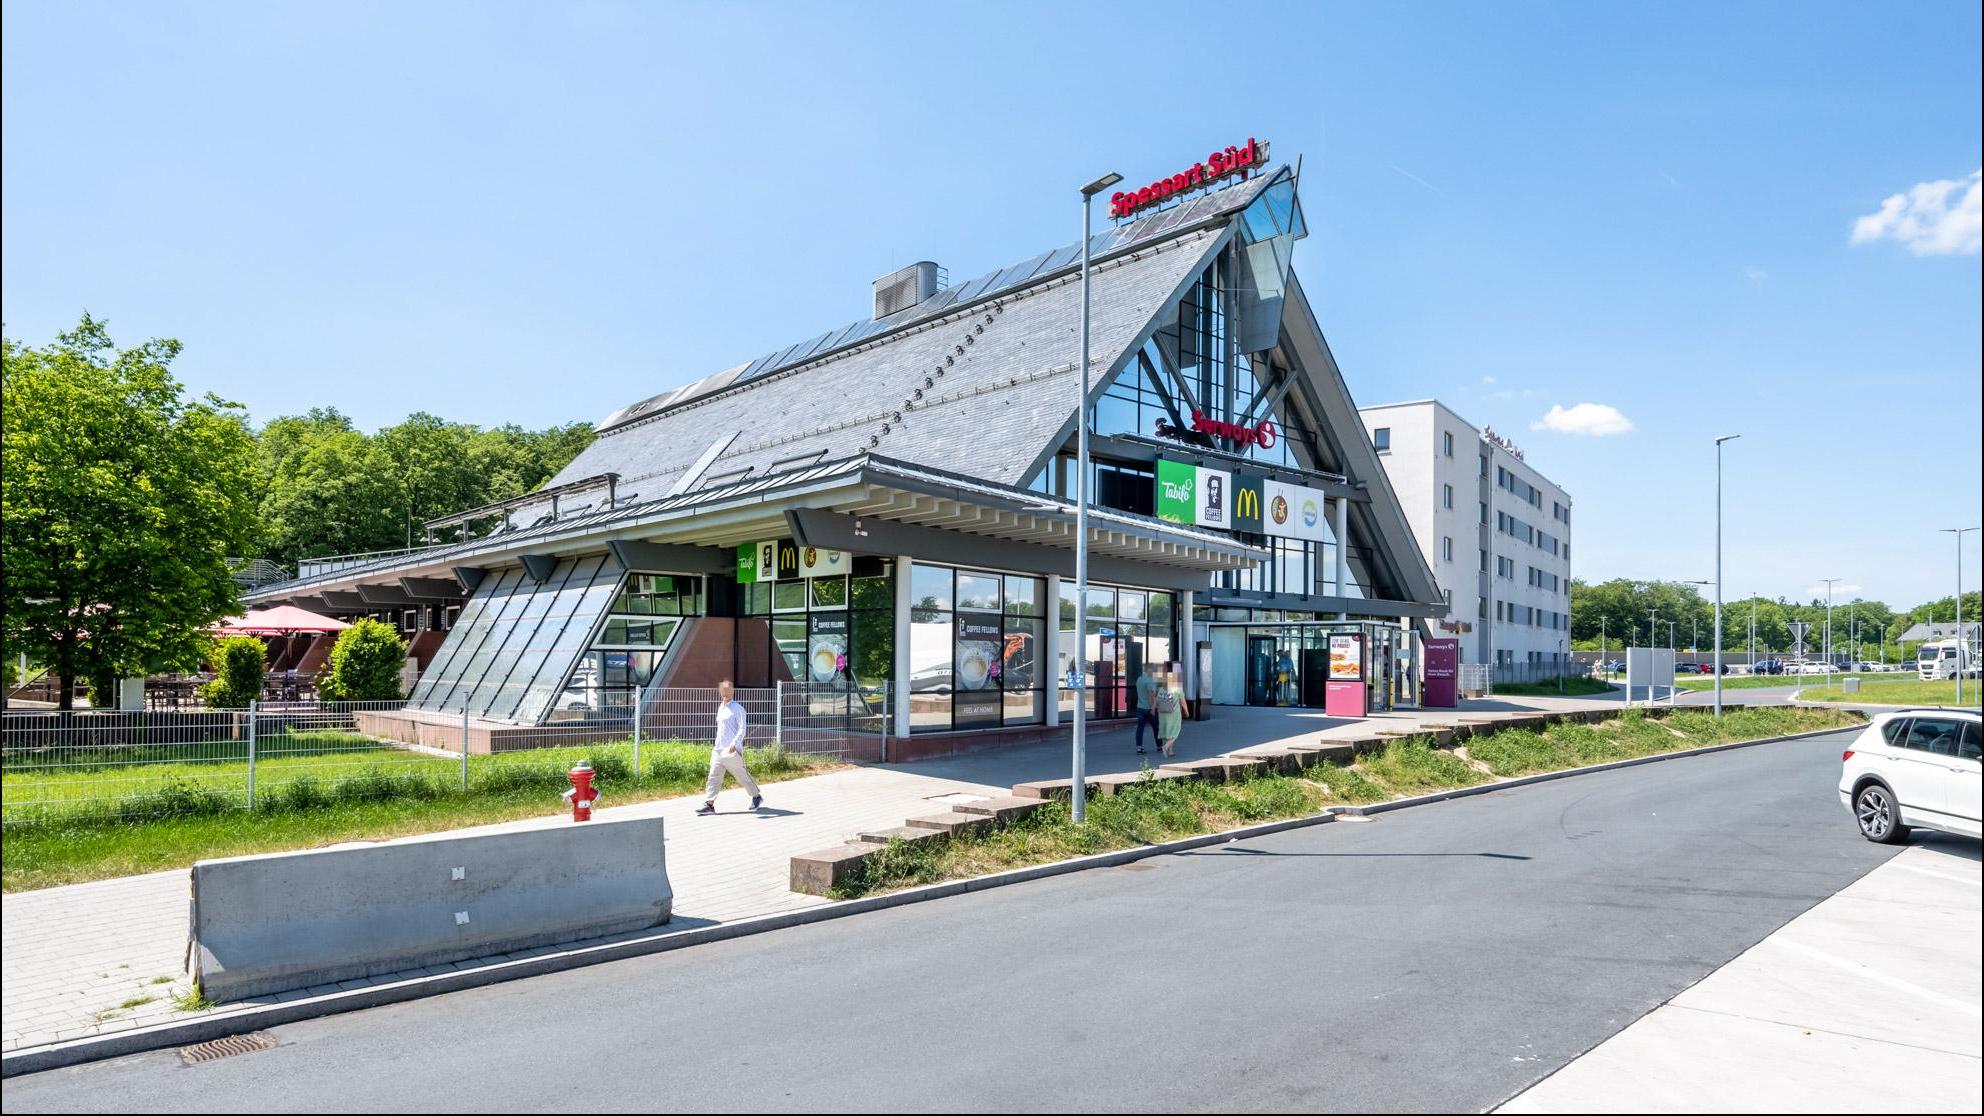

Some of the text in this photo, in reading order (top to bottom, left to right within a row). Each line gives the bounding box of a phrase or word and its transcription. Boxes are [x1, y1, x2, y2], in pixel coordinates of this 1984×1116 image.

[1111, 137, 1257, 217] Spessart Süd
[966, 624, 981, 633] COFFEE
